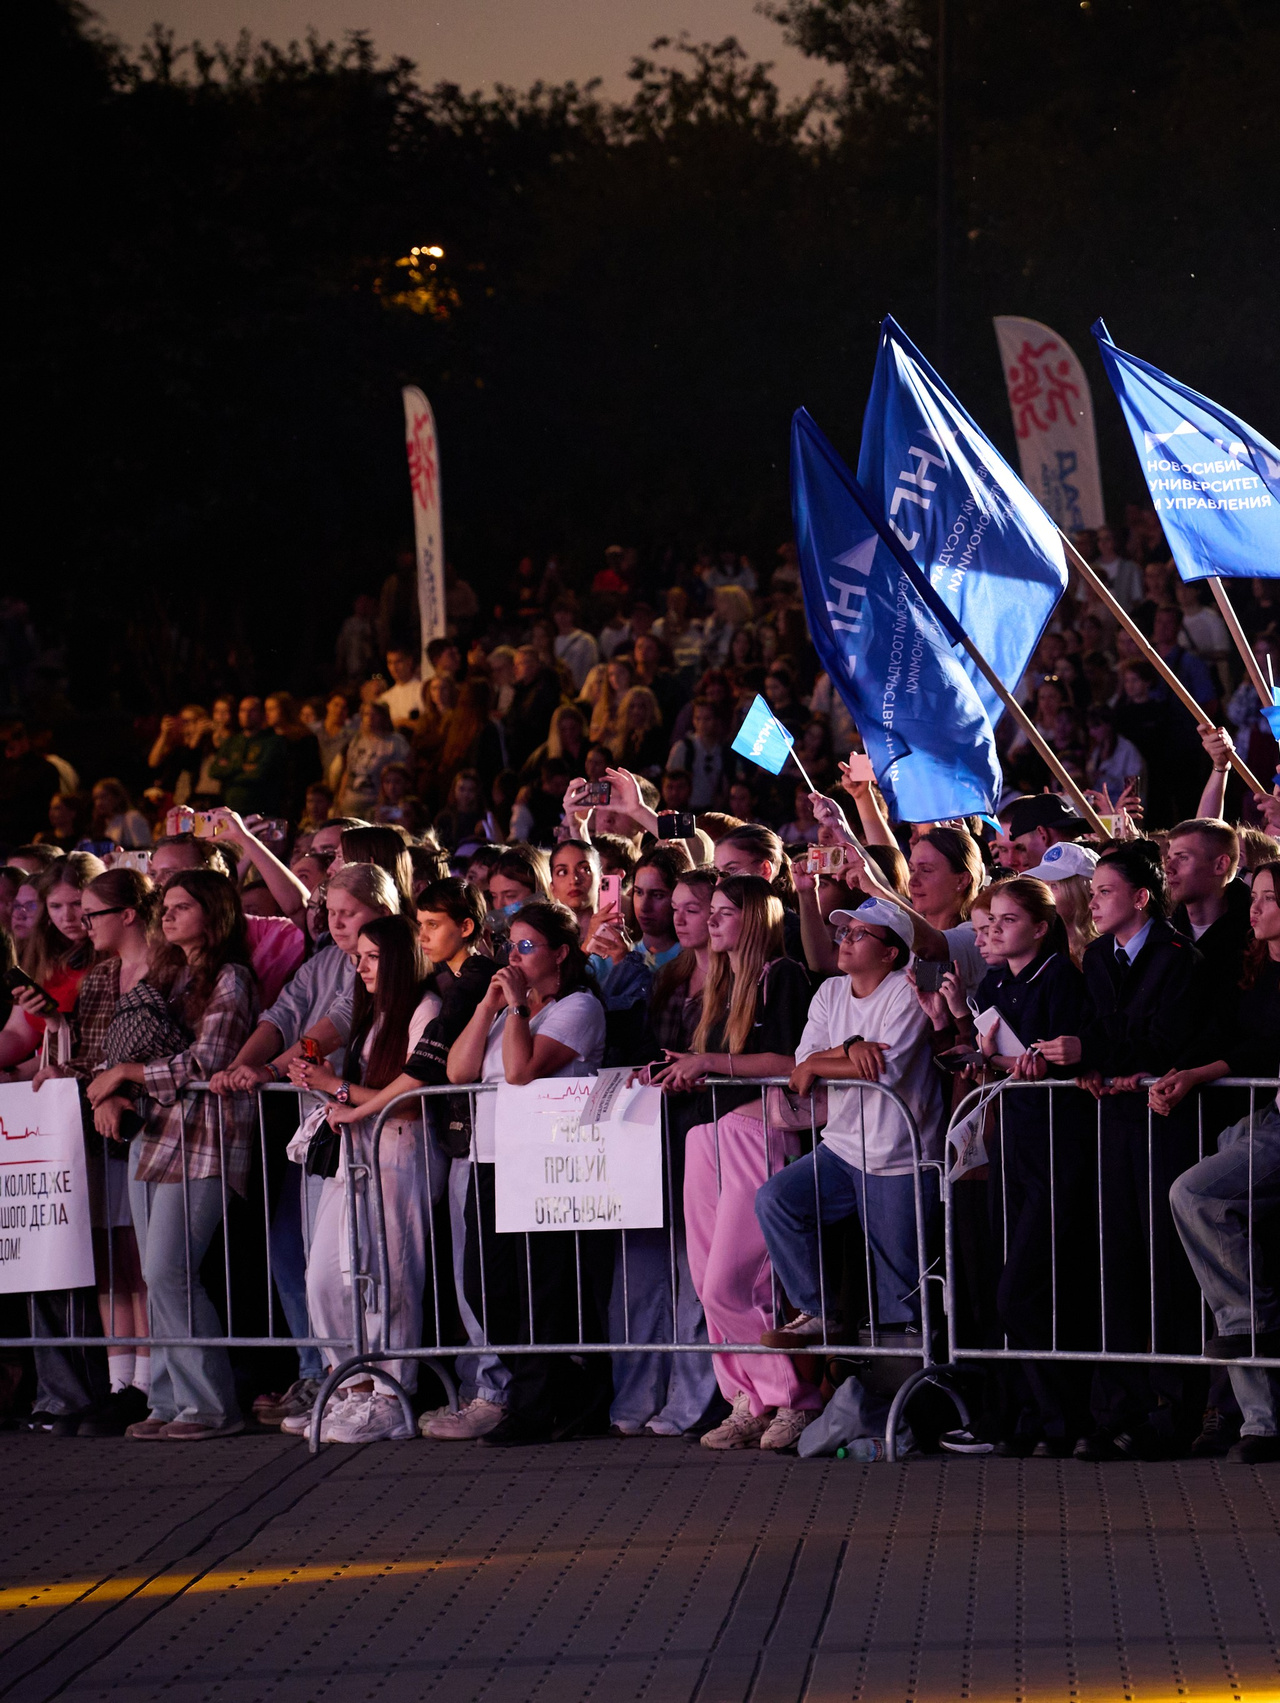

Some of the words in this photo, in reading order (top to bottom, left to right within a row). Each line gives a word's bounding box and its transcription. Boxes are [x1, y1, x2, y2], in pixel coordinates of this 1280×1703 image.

[1150, 477, 1259, 493] УНИВЕРСИТЕТ
[1165, 494, 1271, 511] УПРАВЛЕНИЯ
[5, 1170, 72, 1199] КОЛЛЕДЖЕ
[30, 1203, 69, 1232] ДЕЛА
